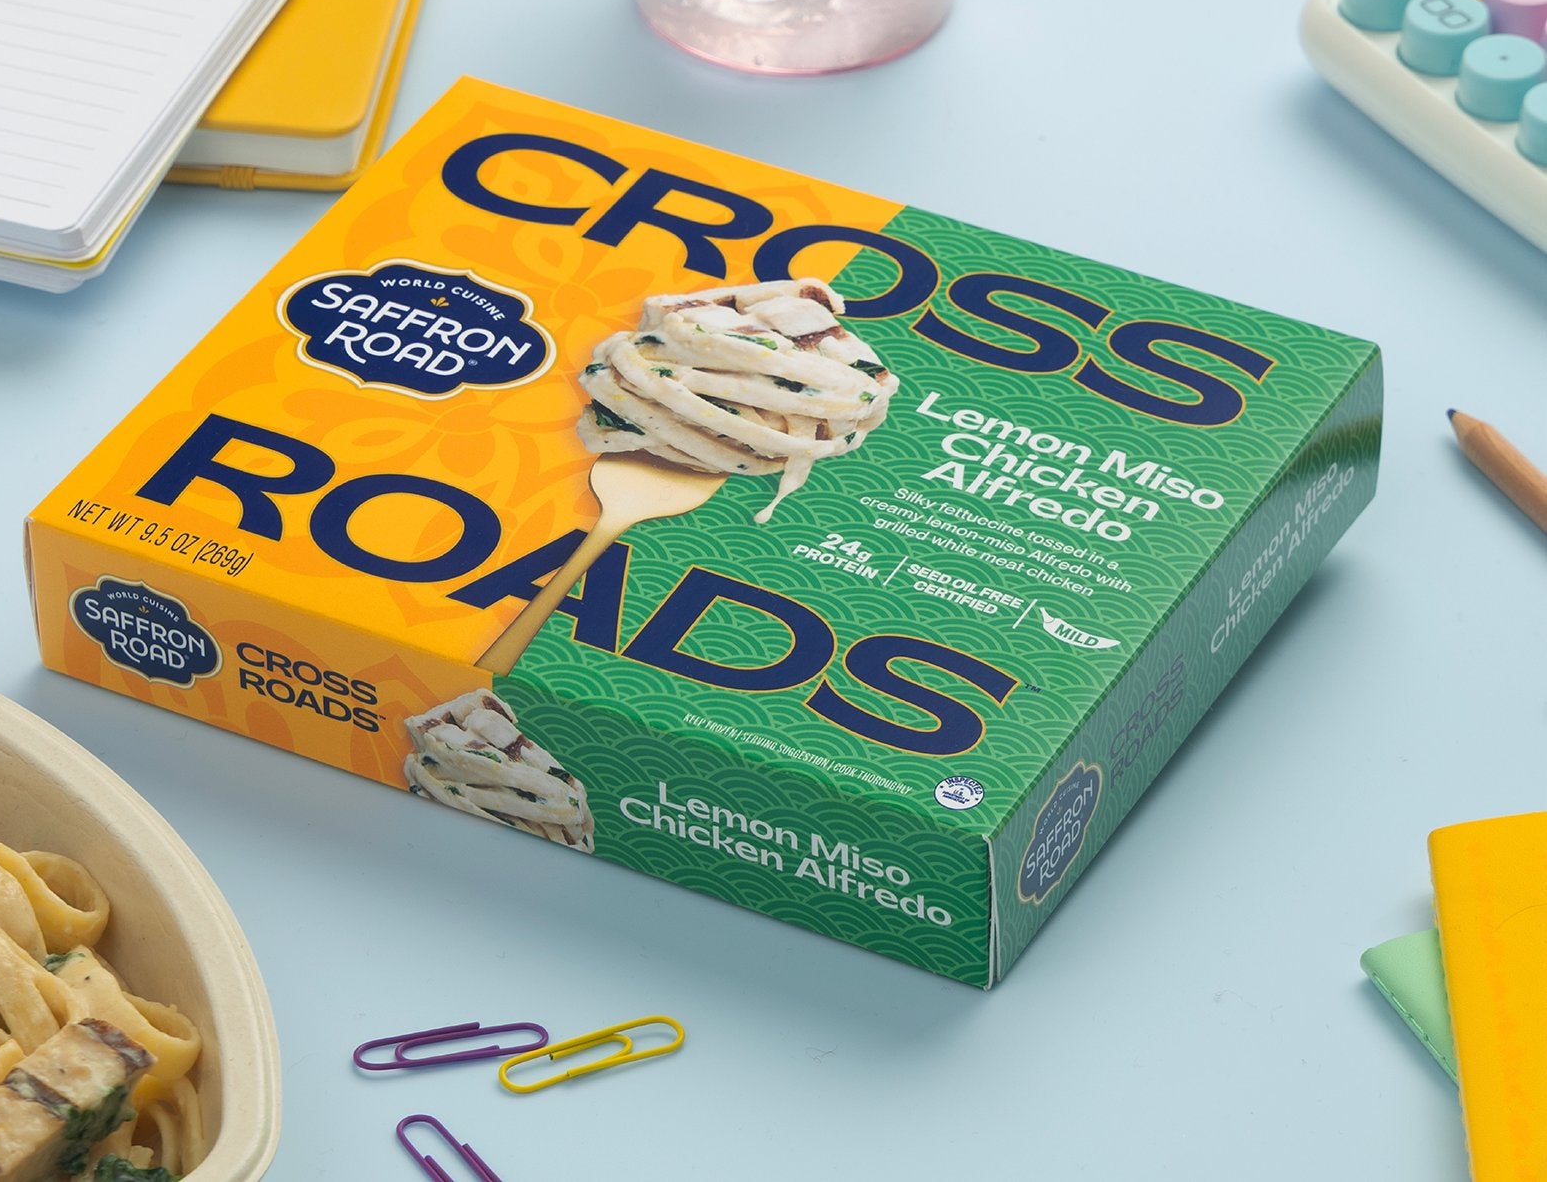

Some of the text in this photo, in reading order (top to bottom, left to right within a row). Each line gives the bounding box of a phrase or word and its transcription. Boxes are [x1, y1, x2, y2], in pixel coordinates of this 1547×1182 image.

[379, 277, 506, 322] WORLD CUISINE
[440, 132, 1279, 428] CROSS
[310, 282, 533, 366] SAFFRON
[323, 319, 466, 376] ROAD
[915, 390, 1225, 511] Lemon Miso
[940, 432, 1161, 522] Chicken
[67, 499, 255, 578] NET WT 9.5 OZ (269g)
[893, 487, 1120, 571] Silky fettuccine tossed in a
[920, 460, 1133, 543] Alfredo
[1227, 461, 1338, 610] Lemon Miso
[134, 411, 1022, 756] ROADS
[791, 543, 881, 582] PROTEIN
[818, 532, 873, 564] 24g
[859, 495, 1133, 594] creamy lemon-miso Alfredo with
[872, 516, 1095, 597] grilled white meat chicken
[1210, 465, 1355, 654] Chicken Alfredo
[84, 597, 206, 657] SAFFRON
[106, 591, 180, 623] WORLD CUISINE
[906, 563, 1026, 610] SEED OIL FREE
[912, 580, 999, 616] CERTIFIED
[110, 628, 187, 669] ROAD
[235, 641, 378, 706] CROSS
[1053, 623, 1100, 648] MILD
[238, 667, 380, 733] ROADS
[1109, 653, 1185, 761] CROSS
[1109, 679, 1185, 790] ROADS
[683, 712, 914, 796] KEEP FROZEN SERVING SUGGESTION COOK THOROUGHLY
[657, 780, 912, 887] Lemon Miso
[1025, 778, 1094, 880] SAFFRON
[1038, 800, 1058, 836] WORLD
[1038, 818, 1082, 887] ROAD
[618, 795, 953, 928] Chicken Alfredo
